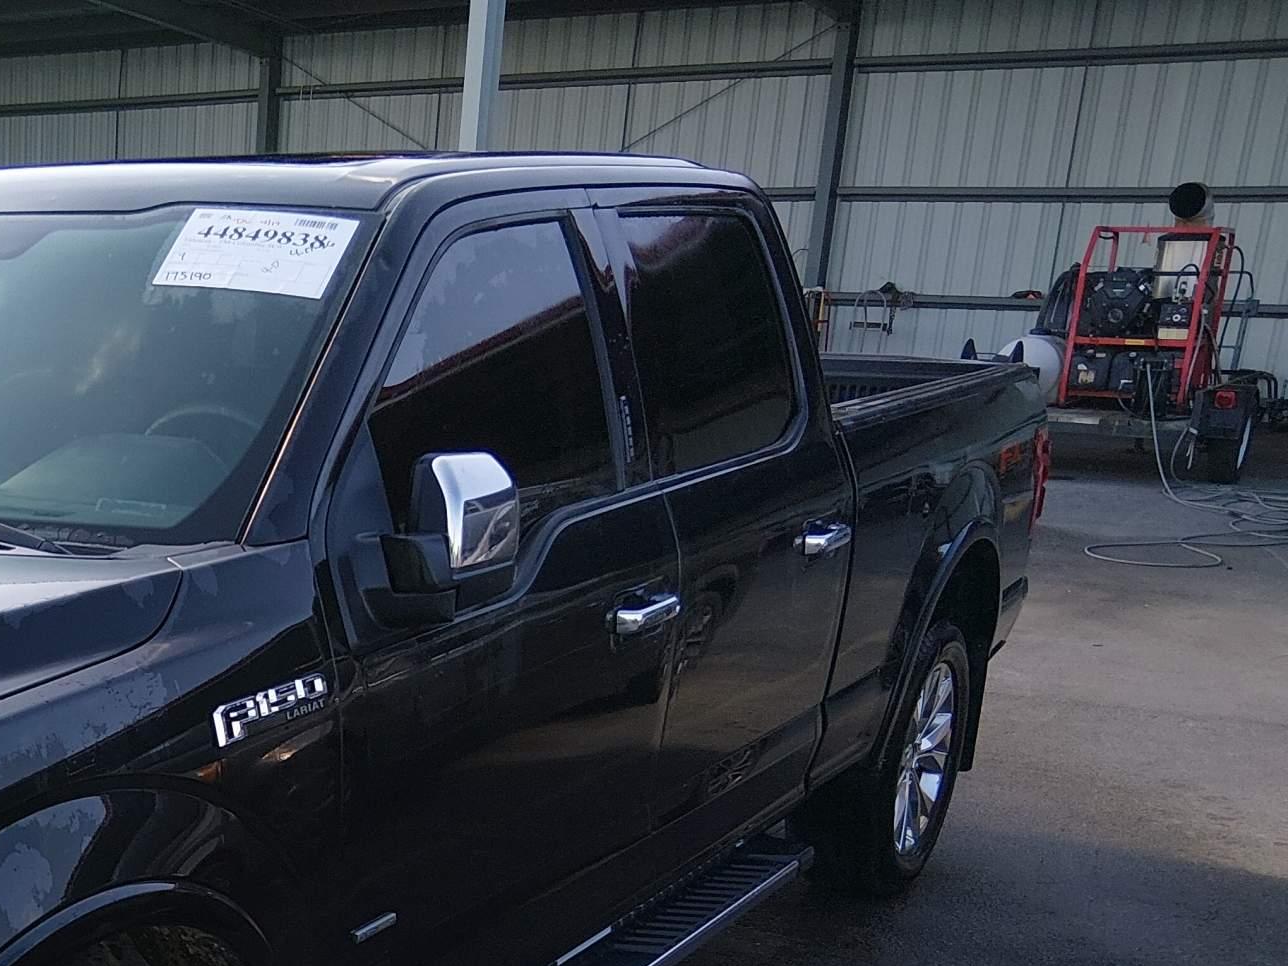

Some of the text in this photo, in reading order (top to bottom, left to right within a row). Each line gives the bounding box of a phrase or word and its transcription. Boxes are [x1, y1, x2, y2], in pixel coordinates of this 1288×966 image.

[197, 224, 328, 249] 44849838
[165, 271, 213, 282] 175190
[286, 698, 326, 721] LARIAT
